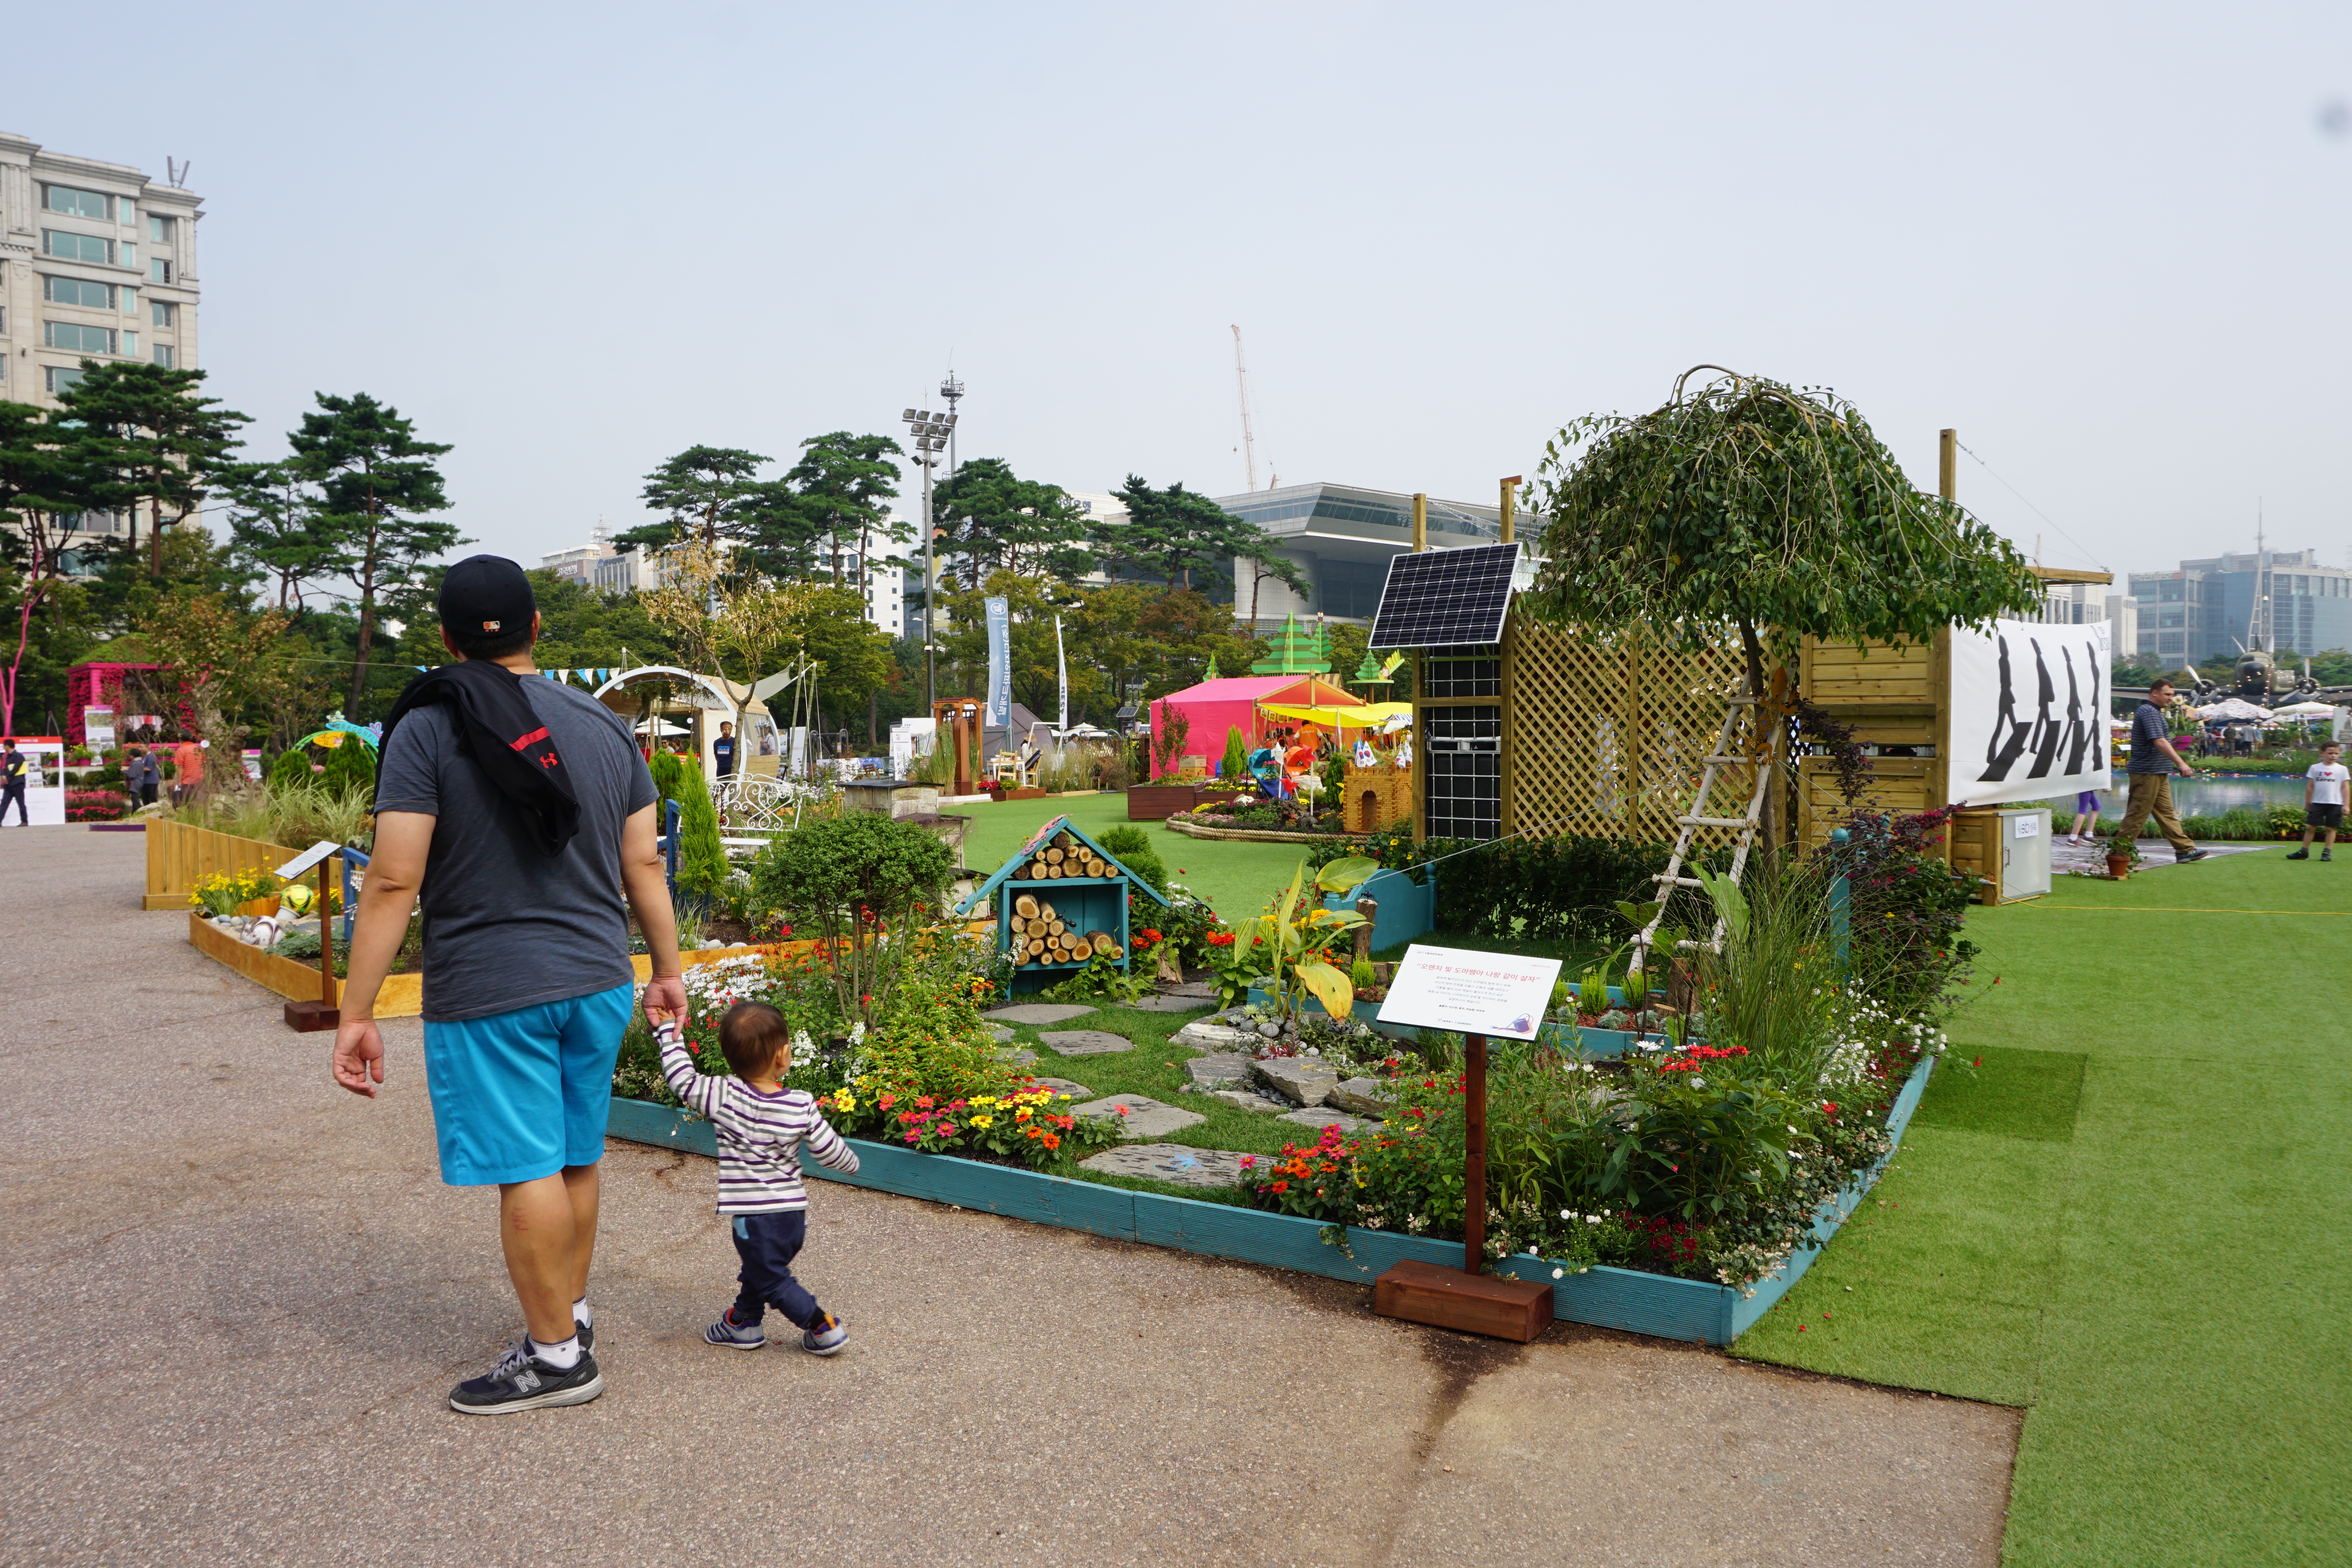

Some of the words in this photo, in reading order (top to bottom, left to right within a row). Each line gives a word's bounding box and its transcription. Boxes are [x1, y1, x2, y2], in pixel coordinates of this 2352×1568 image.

[1453, 967, 1484, 976] 도마뱀아
[577, 1372, 586, 1381] 880
[514, 1370, 541, 1393] N
